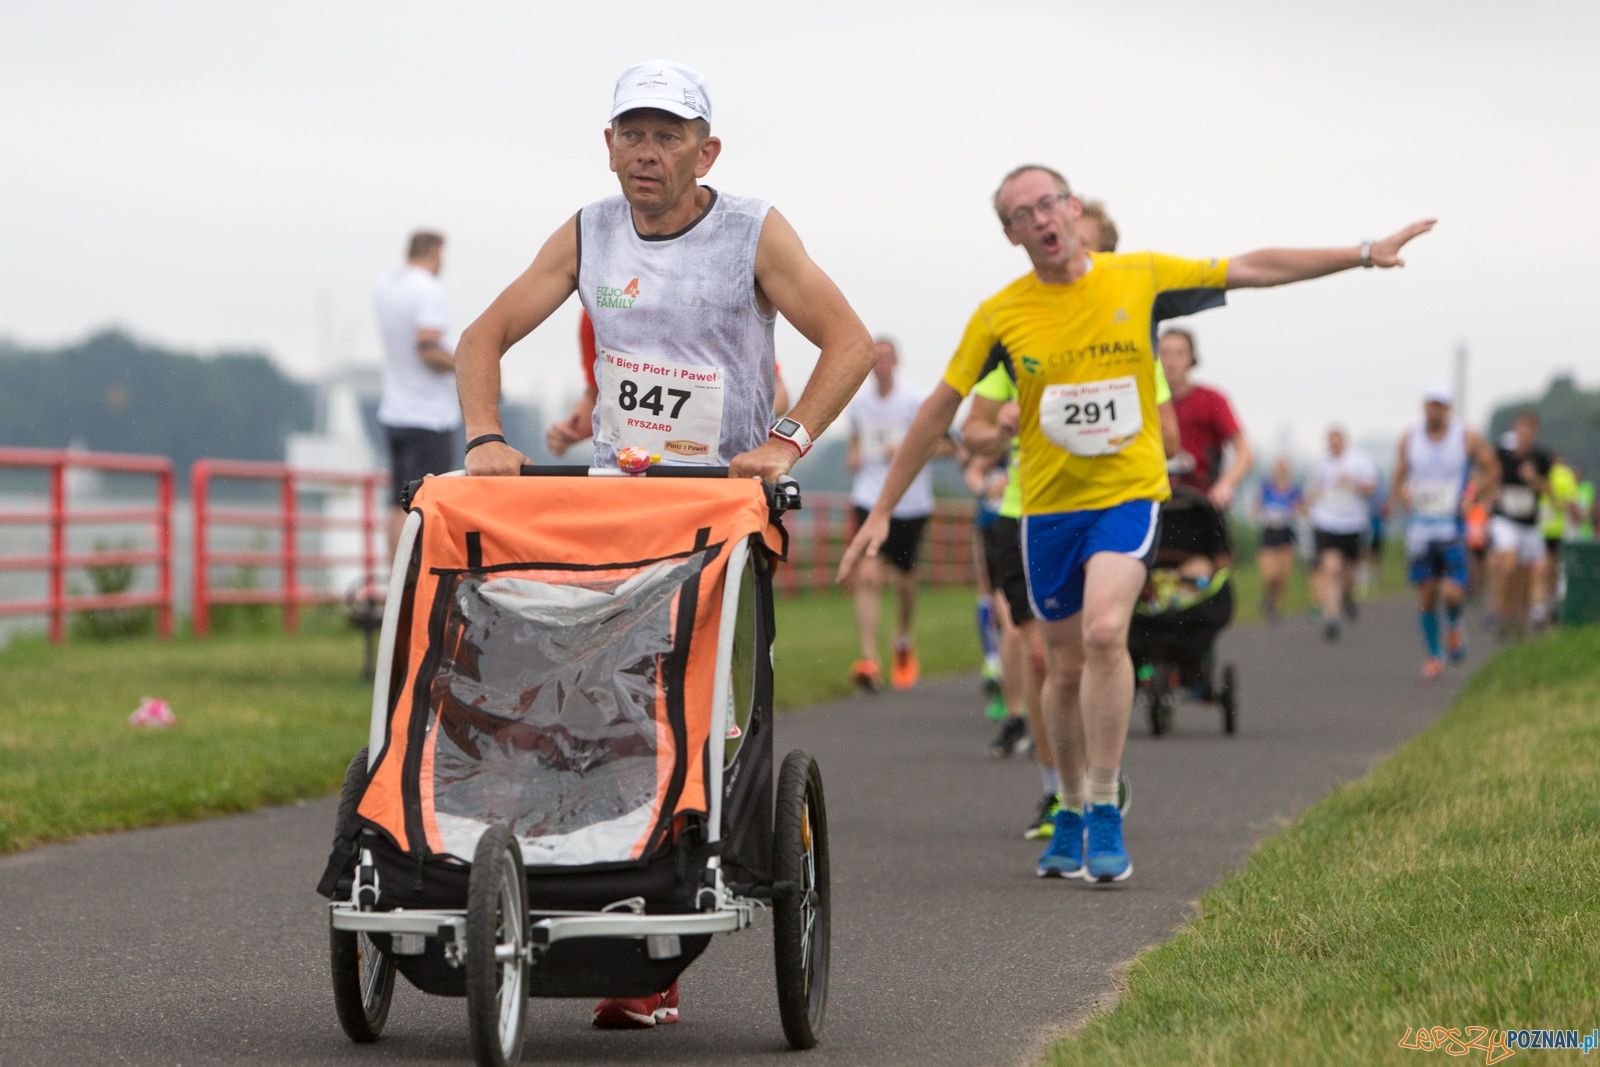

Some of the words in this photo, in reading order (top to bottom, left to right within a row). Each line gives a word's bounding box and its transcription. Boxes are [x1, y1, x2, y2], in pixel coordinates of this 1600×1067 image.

[596, 286, 623, 297] FIZJO
[623, 278, 640, 298] 4
[596, 297, 635, 309] FAMILY
[1048, 340, 1138, 367] CITYTRAIL
[617, 357, 639, 372] Bieg
[642, 363, 671, 376] Piotr
[673, 368, 677, 377] i
[681, 370, 717, 382] Paweł
[618, 379, 692, 419] 847
[1064, 400, 1117, 425] 291
[627, 418, 672, 432] RYSZARD
[666, 442, 682, 450] Piotr
